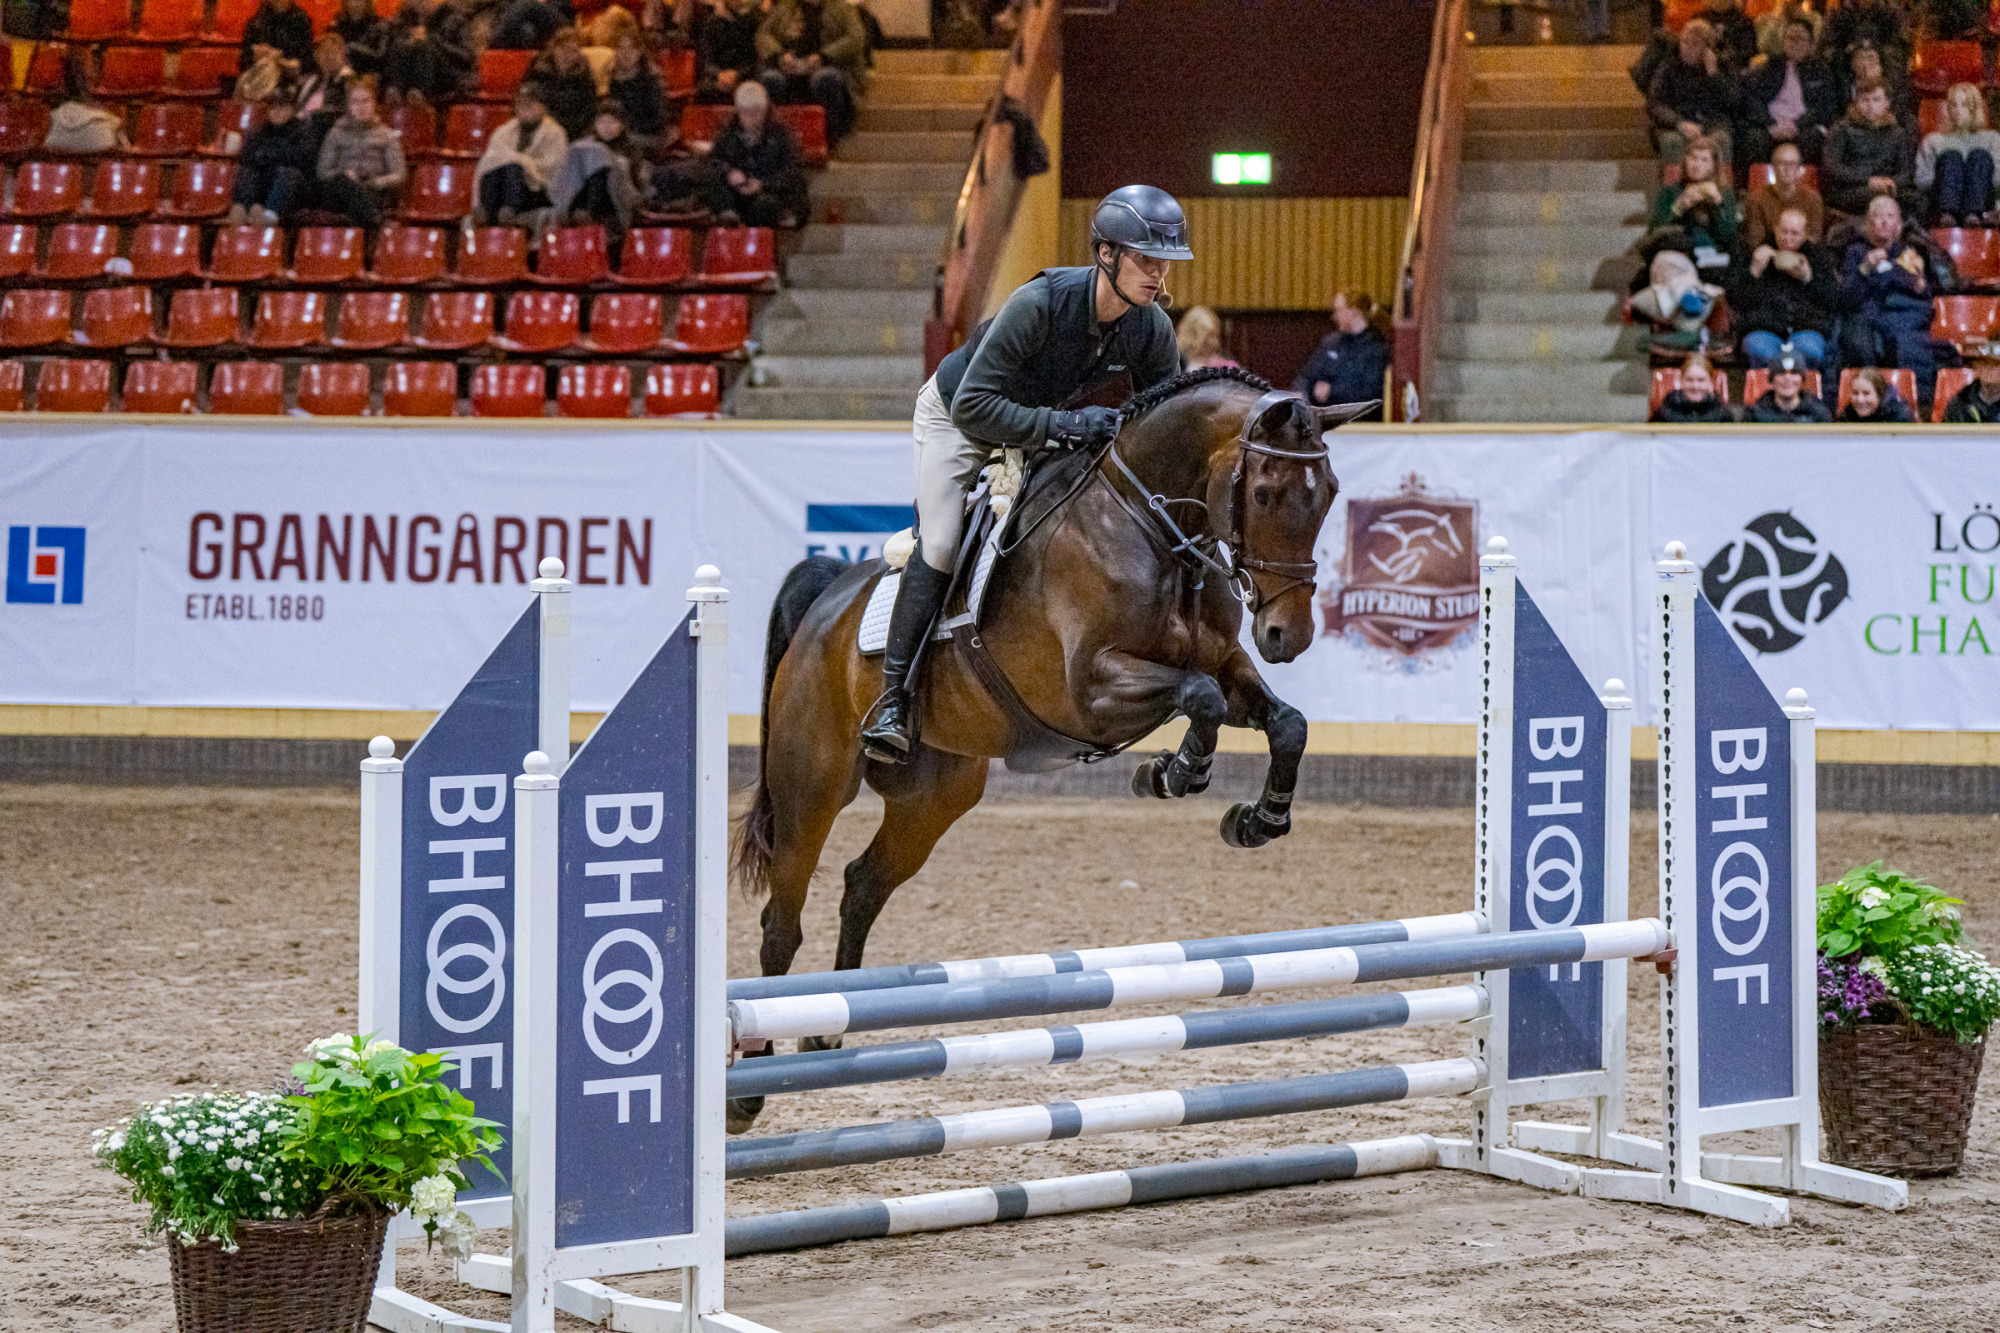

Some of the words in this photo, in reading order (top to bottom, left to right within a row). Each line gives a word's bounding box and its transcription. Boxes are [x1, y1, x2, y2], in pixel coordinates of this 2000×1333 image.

[188, 512, 653, 586] GRANNGÅRDEN
[1342, 590, 1431, 618] HYPERION
[1435, 592, 1479, 619] STUD
[426, 774, 506, 1089] BHOOF
[583, 792, 664, 1124] BHOOF
[1711, 727, 1769, 1004] BHOOF
